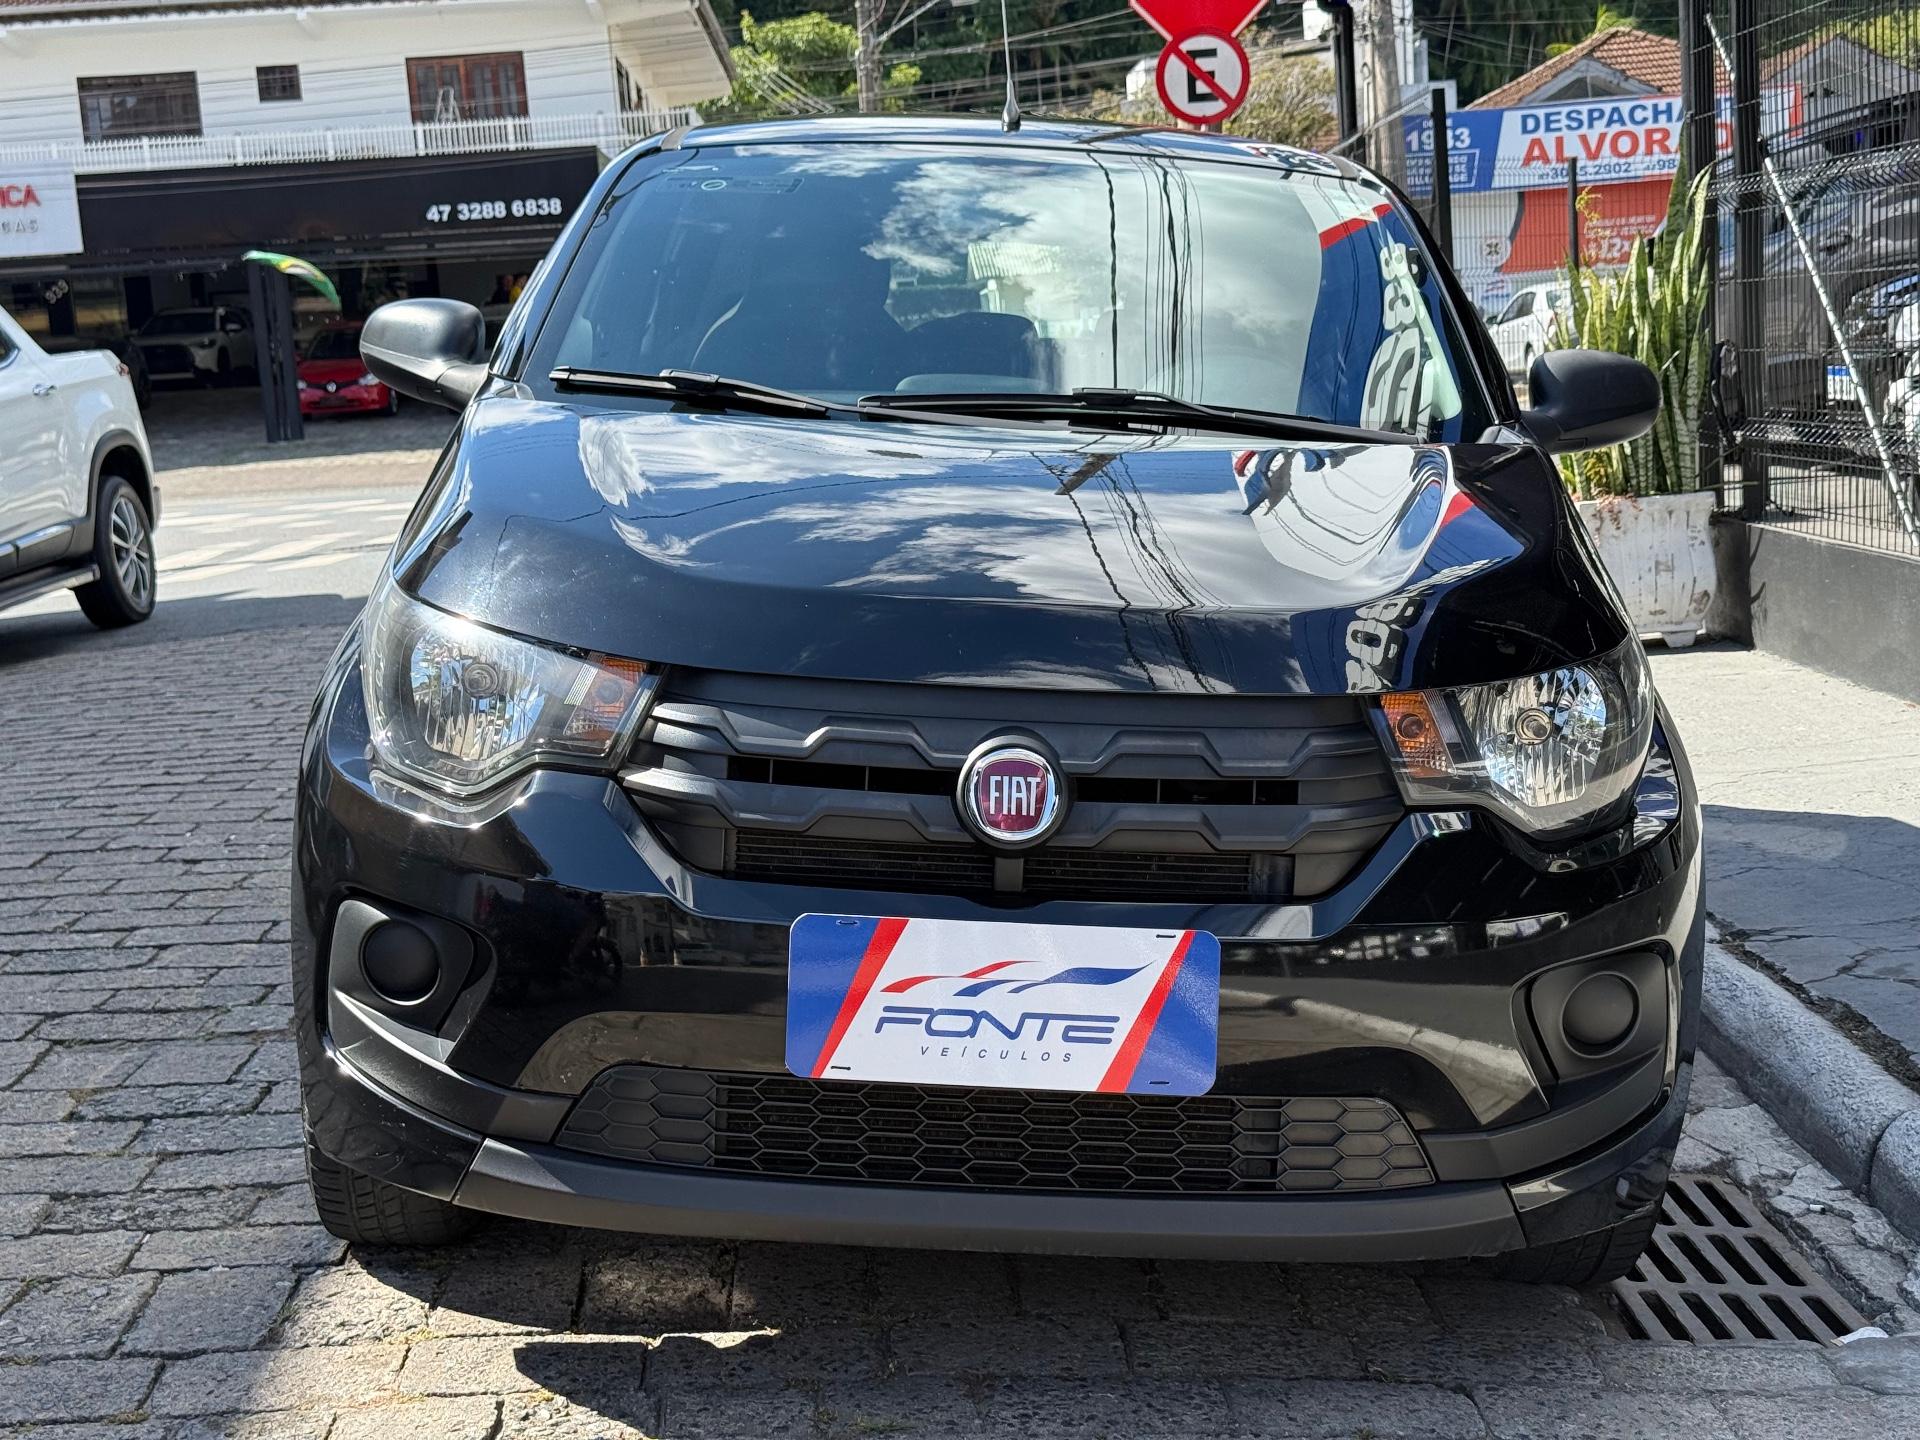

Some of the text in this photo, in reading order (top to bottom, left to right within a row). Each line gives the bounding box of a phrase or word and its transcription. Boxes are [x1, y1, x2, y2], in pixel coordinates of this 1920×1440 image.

[1186, 48, 1220, 103] E
[425, 197, 562, 223] 47 3288 6838
[989, 775, 1041, 817] FIAT
[875, 1005, 1121, 1045] FONTE
[920, 1045, 1073, 1063] VEÍCULOS
